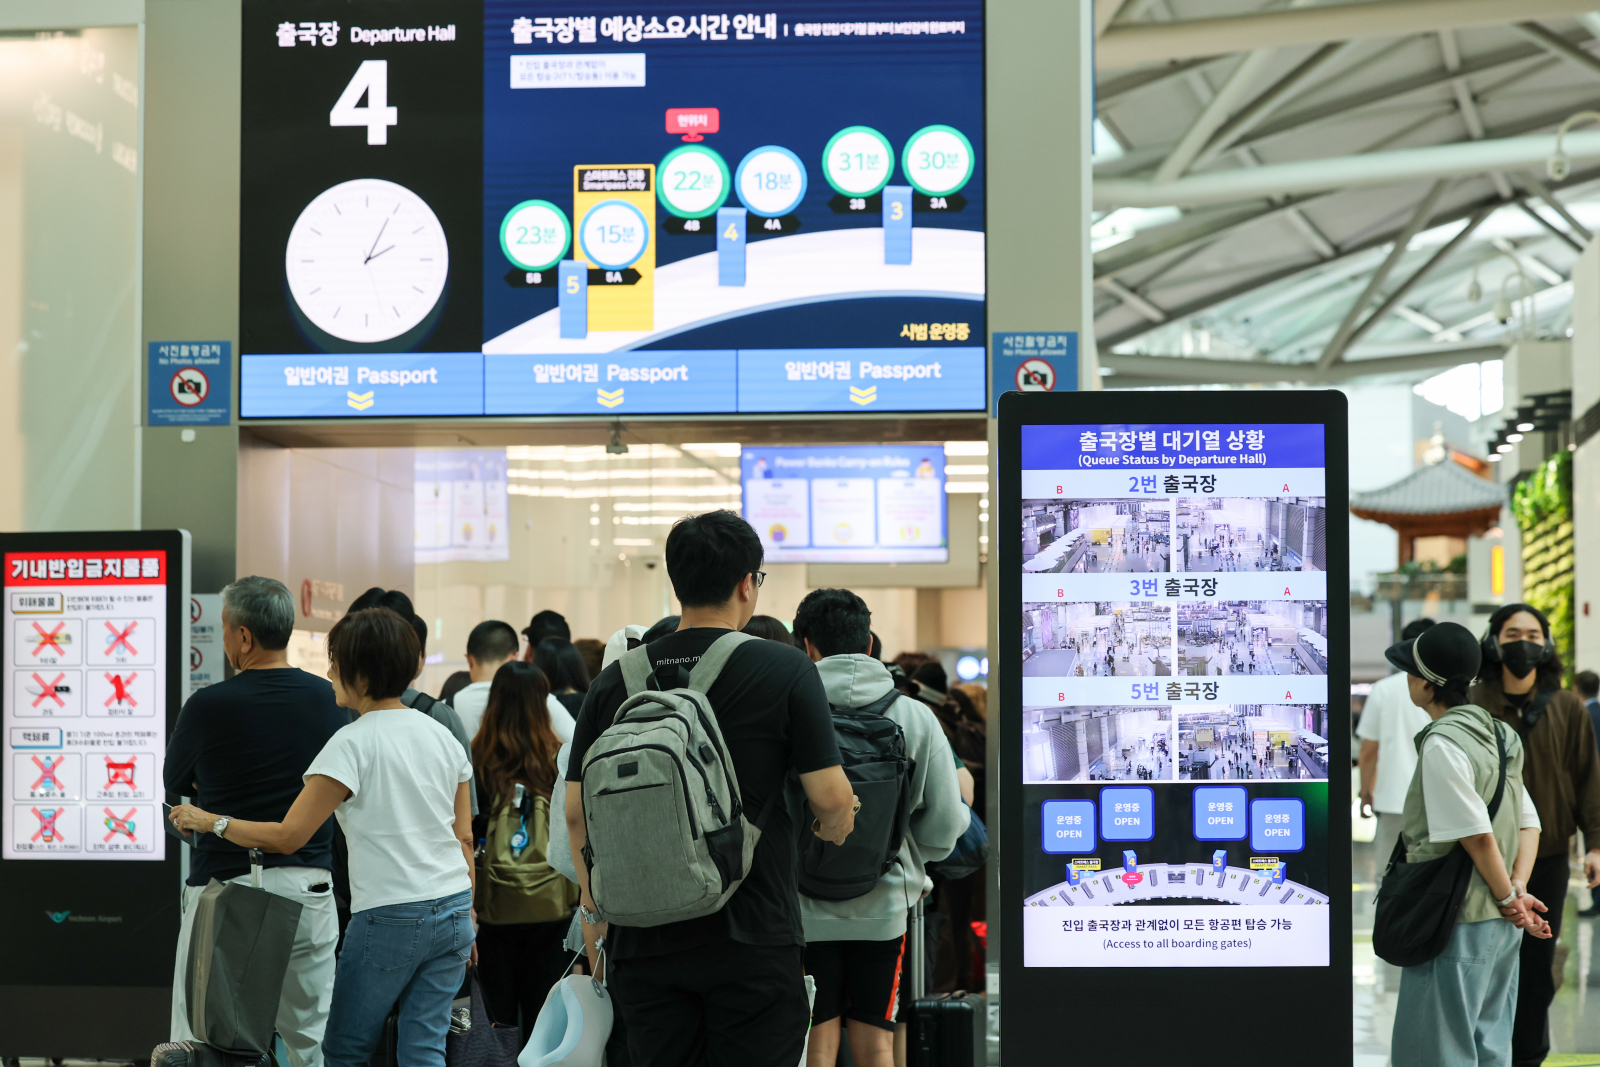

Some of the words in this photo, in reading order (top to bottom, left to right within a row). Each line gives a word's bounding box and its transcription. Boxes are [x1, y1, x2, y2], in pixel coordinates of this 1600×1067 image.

[276, 21, 340, 47] 출국장
[350, 26, 427, 46] Departure
[428, 24, 456, 43] Hall
[511, 16, 597, 44] 출국장별
[600, 15, 730, 43] 예상소요시간
[732, 13, 777, 40] 안내
[329, 59, 398, 146] 4
[677, 113, 708, 128] 현위치
[839, 152, 881, 172] 31분
[918, 151, 961, 171] 30분
[673, 170, 715, 191] 22분
[753, 172, 793, 191] 18분
[849, 198, 866, 210] 3B
[930, 197, 948, 210] 3A
[890, 201, 904, 220] 3
[684, 219, 701, 232] 4B
[764, 218, 782, 231] 4A
[516, 226, 557, 245] 23분
[596, 224, 635, 244] 15분
[723, 223, 739, 241] 4
[525, 271, 543, 284] 5B
[605, 270, 623, 283] 5A
[566, 276, 580, 294] 5
[900, 323, 928, 342] 시범
[929, 322, 971, 342] 운영중
[284, 366, 349, 386] 일반여권
[357, 366, 438, 386] Passport
[534, 363, 599, 384] 일반여권
[607, 363, 689, 384] Passport
[785, 361, 851, 381] 일반여권
[859, 361, 942, 381] Passport
[1079, 431, 1157, 451] 출국장별
[1162, 430, 1220, 451] 대기열
[1226, 429, 1265, 450] 상황
[1078, 454, 1120, 467] (Queue
[1122, 453, 1159, 466] Status
[1161, 453, 1176, 467] by
[1178, 453, 1238, 466] Departure
[1239, 453, 1267, 466] Hall)
[1056, 485, 1063, 495] B
[1128, 474, 1158, 494] 2번
[1163, 474, 1217, 494] 출국장
[1282, 483, 1290, 493] A
[11, 557, 160, 580] 기내반입금지물품
[1057, 588, 1065, 598] B
[1129, 578, 1159, 598] 3번
[1164, 577, 1218, 597] 출국장
[1283, 586, 1291, 596] A
[1058, 692, 1065, 702] B
[1131, 682, 1160, 701] 5번
[1165, 681, 1220, 701] 출국장
[1285, 690, 1293, 700] A
[1114, 802, 1140, 813] 운영중
[1207, 801, 1234, 812] 운영중
[1056, 815, 1082, 826] 운영중
[1114, 816, 1140, 826] OPEN
[1207, 816, 1234, 826] OPEN
[1264, 813, 1291, 824] 운영중
[1056, 829, 1082, 839] OPEN
[1264, 827, 1291, 838] OPEN
[1128, 858, 1136, 867] 4
[1214, 858, 1222, 867] 3
[1072, 870, 1079, 880] 5
[1273, 869, 1281, 879] 2
[1062, 919, 1084, 931] 진입
[1087, 919, 1132, 932] 출국장과
[1135, 919, 1180, 931] 관계없이
[1183, 919, 1205, 931] 모든
[1208, 919, 1242, 931] 항공편
[1245, 919, 1266, 931] 탑승
[1270, 918, 1293, 930] 가능
[1102, 938, 1140, 950] (Access
[1143, 939, 1154, 948] to
[1156, 938, 1169, 948] all
[1171, 938, 1218, 950] boarding
[1220, 938, 1252, 951] gates)
